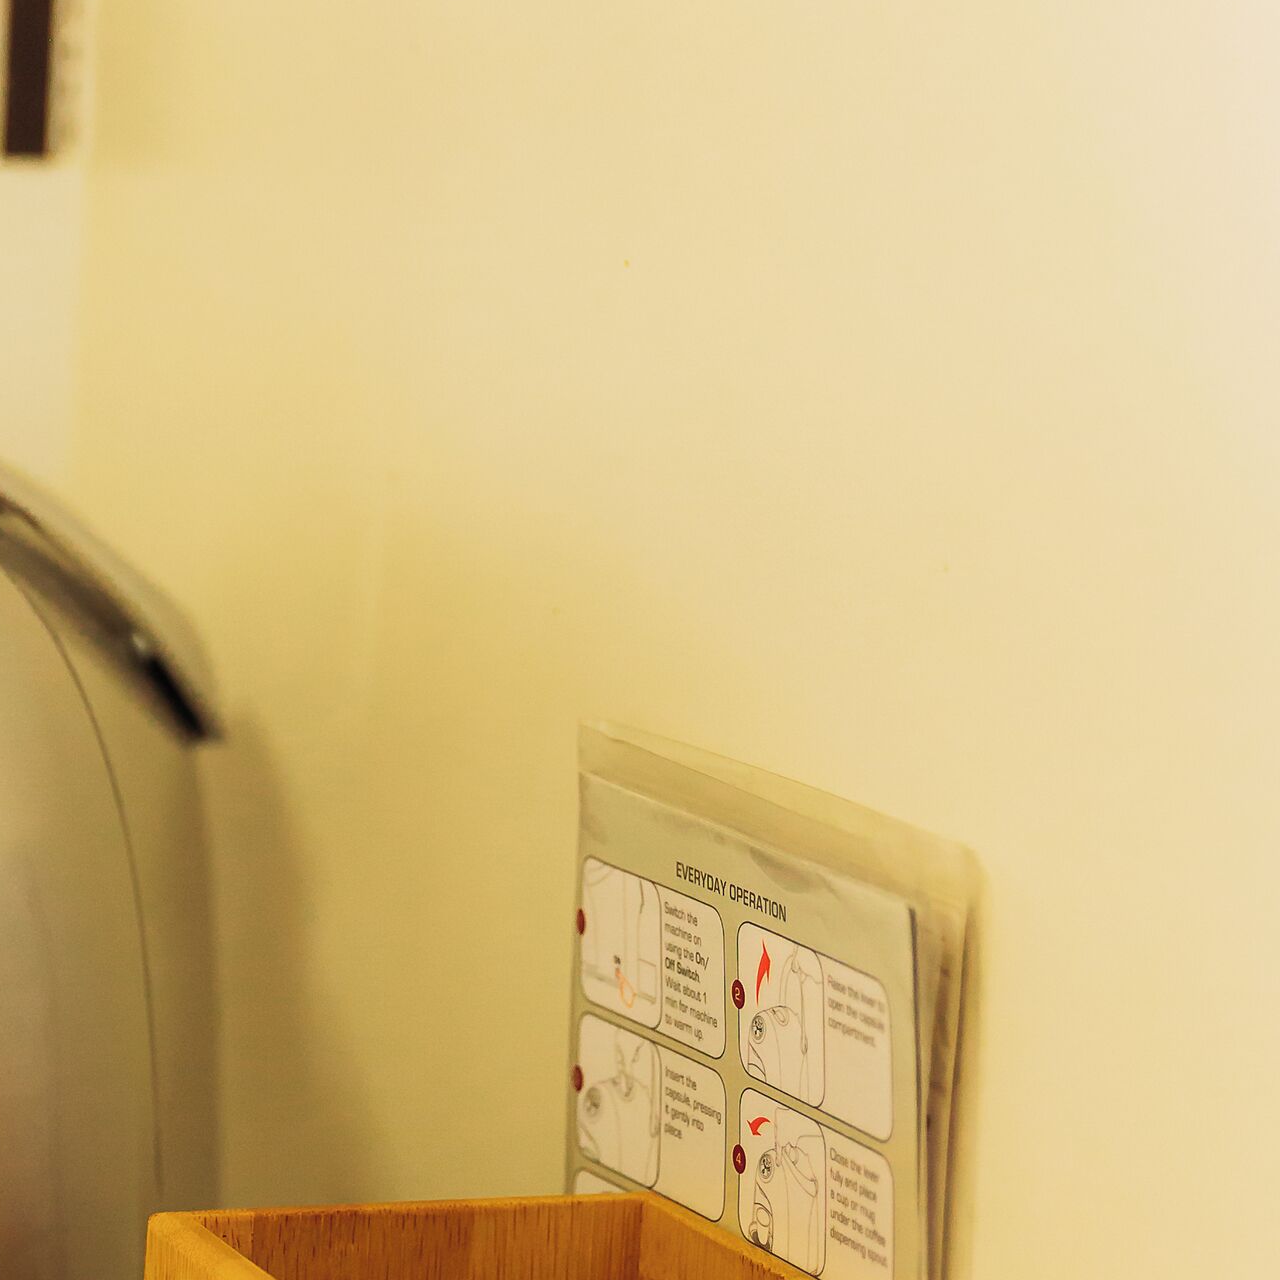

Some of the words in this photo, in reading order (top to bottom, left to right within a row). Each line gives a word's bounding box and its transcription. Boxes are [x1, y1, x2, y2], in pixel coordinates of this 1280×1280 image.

[676, 861, 727, 897] EVERYDAY
[729, 883, 787, 923] OPERATION
[664, 901, 686, 921] Switch
[687, 911, 698, 927] the
[664, 923, 692, 943] machine
[693, 935, 702, 947] on
[683, 947, 694, 962] the
[665, 956, 676, 972] Off
[677, 961, 701, 983] Switch
[683, 984, 702, 1002] about
[703, 992, 708, 1005] 1
[735, 986, 741, 1001] 2
[690, 1007, 718, 1029] machine
[736, 1152, 741, 1163] 4
